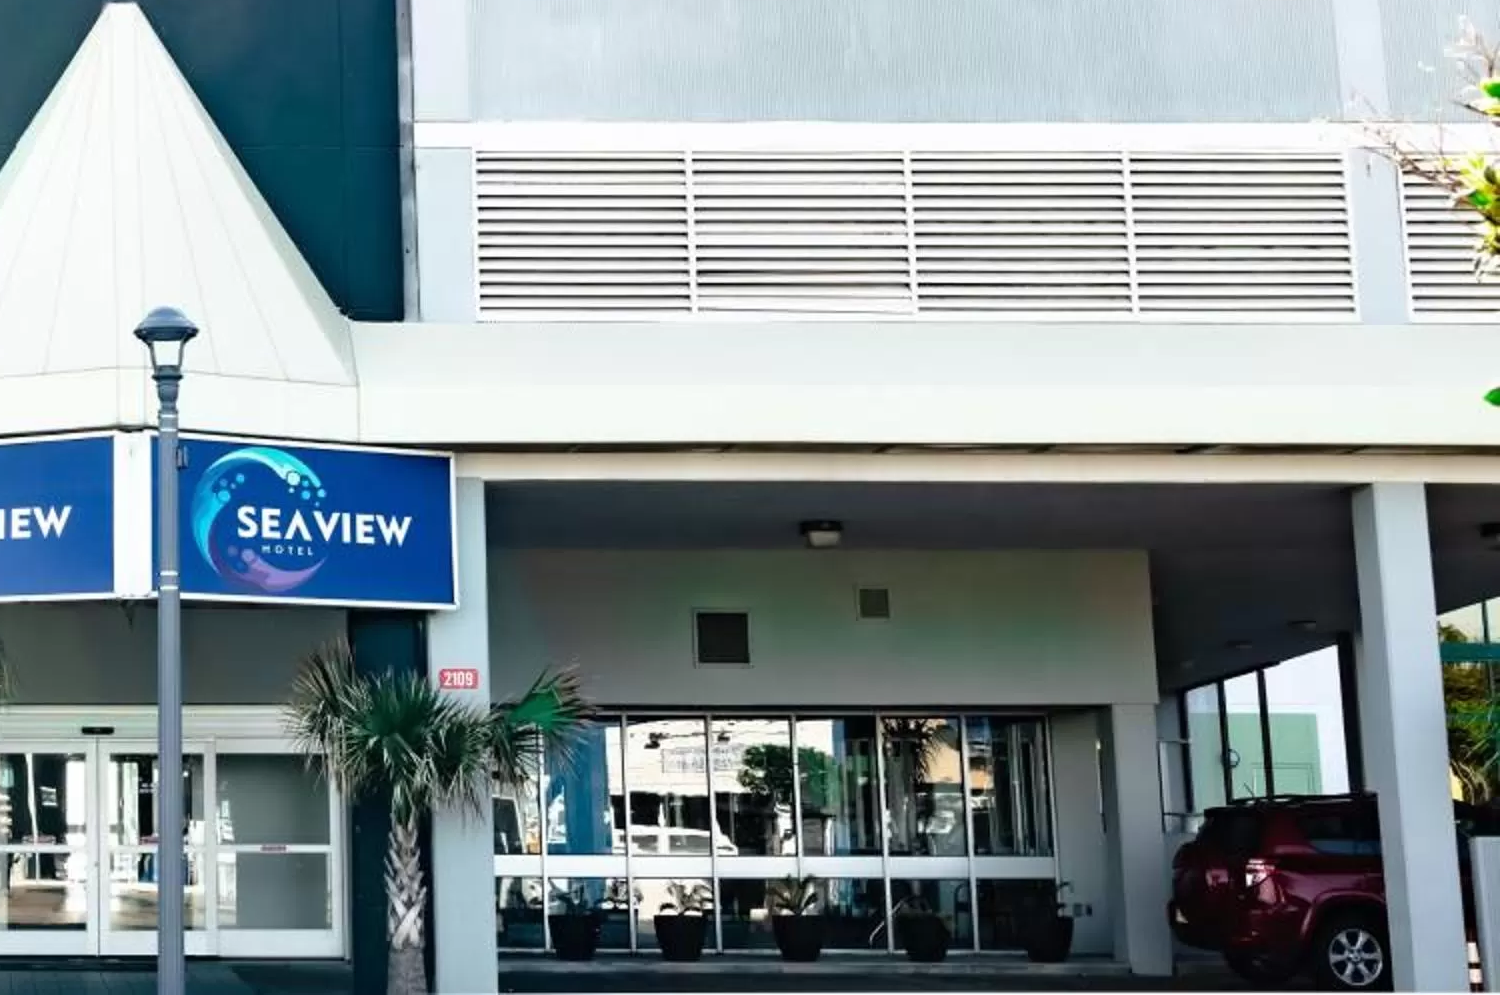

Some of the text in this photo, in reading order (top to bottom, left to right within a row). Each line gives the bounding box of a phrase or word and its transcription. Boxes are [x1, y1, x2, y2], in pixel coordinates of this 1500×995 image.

[237, 506, 412, 548] SEAVIEW
[261, 545, 314, 556] HOTEL
[443, 670, 474, 686] 2109
